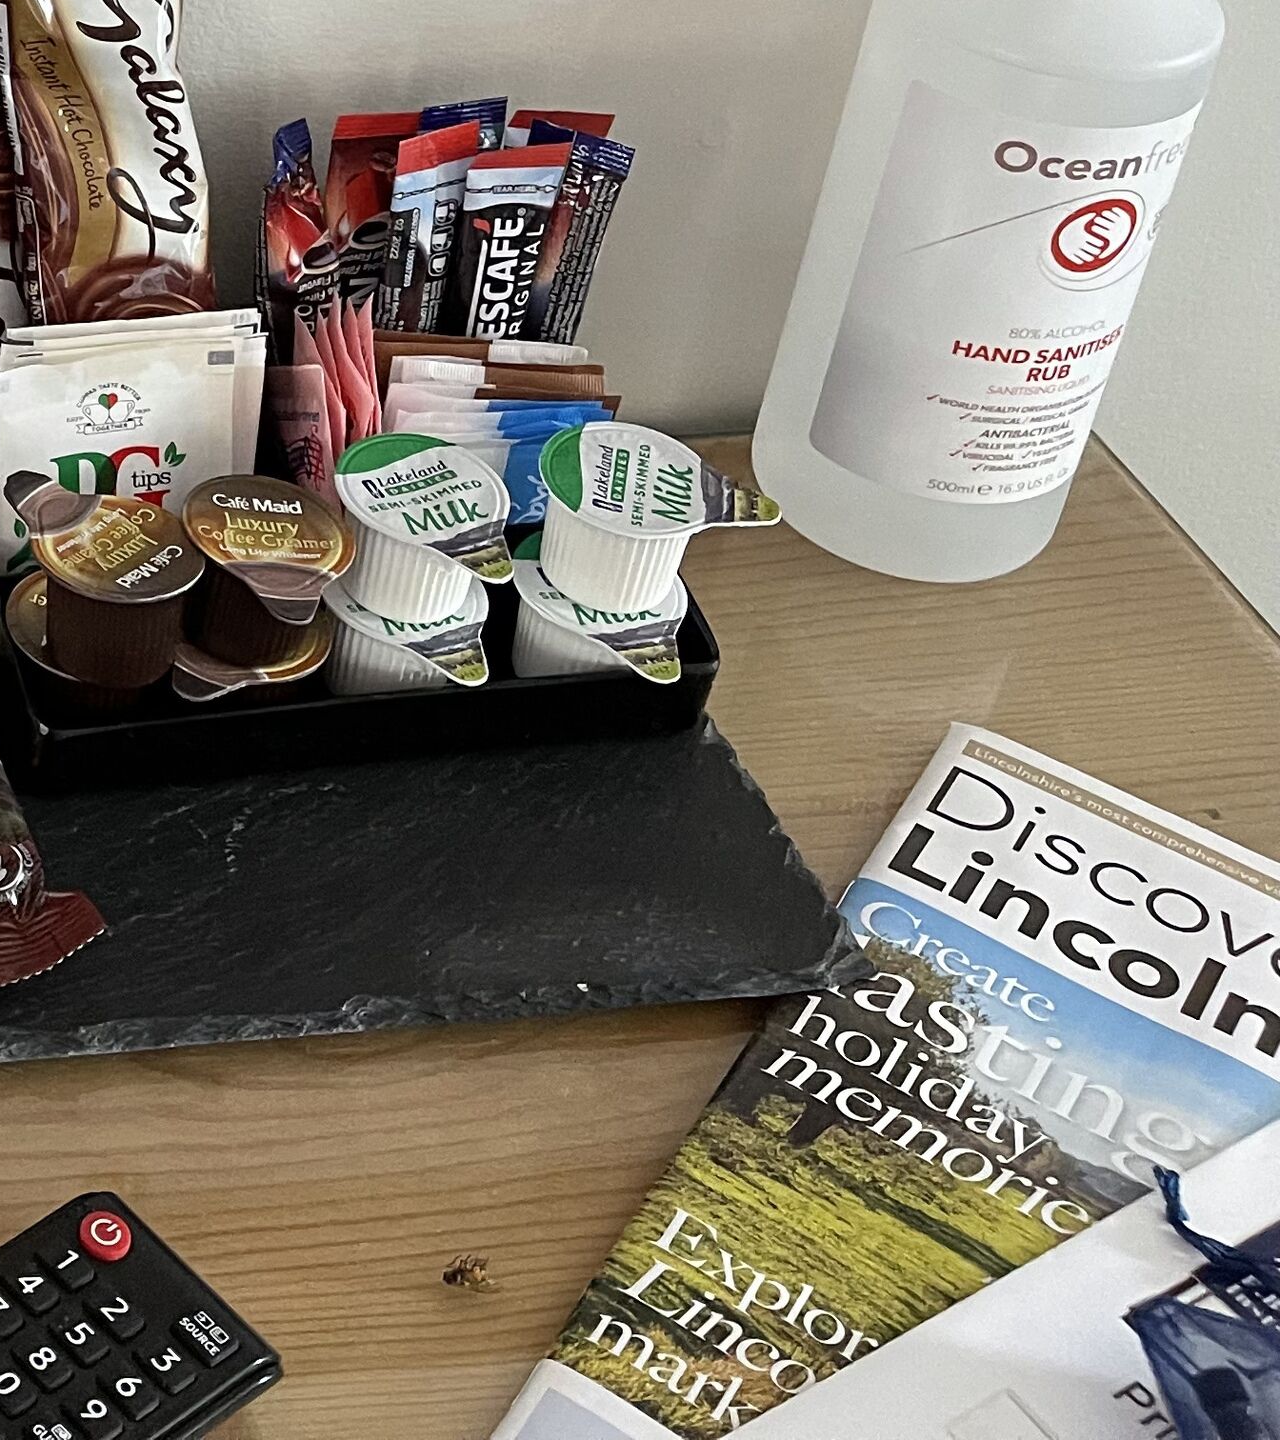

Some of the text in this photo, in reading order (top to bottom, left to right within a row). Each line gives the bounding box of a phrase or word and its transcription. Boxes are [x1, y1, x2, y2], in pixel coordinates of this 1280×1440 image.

[20, 36, 105, 211] Instant Hot Chocolate
[509, 223, 544, 337] RIGINAL
[1008, 327, 1041, 339] 80%
[951, 340, 1030, 364] HAND
[986, 384, 1056, 396] SANITISING
[1026, 364, 1071, 383] RUB
[979, 420, 1071, 439] ANTIBACTERIAL
[132, 470, 171, 491] tips
[377, 460, 448, 487] Lakeland
[595, 444, 614, 499] Lakeland
[611, 450, 630, 502] DAIRIES
[631, 444, 651, 527] SEMI-SKIMMED
[926, 478, 976, 495] 500ml
[997, 482, 1026, 496] 16.9
[1026, 478, 1043, 491] US
[212, 493, 303, 515] Café Maid
[368, 479, 483, 513] SEMI-SKIMMED
[651, 463, 693, 524] Milk
[224, 511, 299, 539] Luxury
[401, 498, 489, 536] Milk
[61, 507, 156, 570] Coffee Creame
[94, 533, 158, 571] Luxury
[197, 525, 336, 551] Coffee Creamer
[115, 545, 183, 589] Café Maid
[974, 747, 1082, 804] Lincolnshire's
[1086, 800, 1130, 827] most
[1133, 821, 1260, 886] comprehensive
[889, 823, 1280, 1058] Lincoln
[860, 902, 1056, 1022] Create
[785, 995, 1049, 1164] holiday
[760, 1048, 1090, 1236] memorie
[57, 1249, 80, 1270] 1
[18, 1276, 44, 1294] 4
[649, 1207, 879, 1361] Explor
[99, 1296, 129, 1322] 2
[617, 1258, 816, 1394] Linco
[64, 1322, 95, 1345] 5
[178, 1316, 221, 1357] SOURCE
[28, 1347, 57, 1371] 8
[150, 1347, 182, 1372] 3
[585, 1314, 763, 1431] mark
[115, 1377, 143, 1397] 6
[80, 1399, 108, 1419] 9
